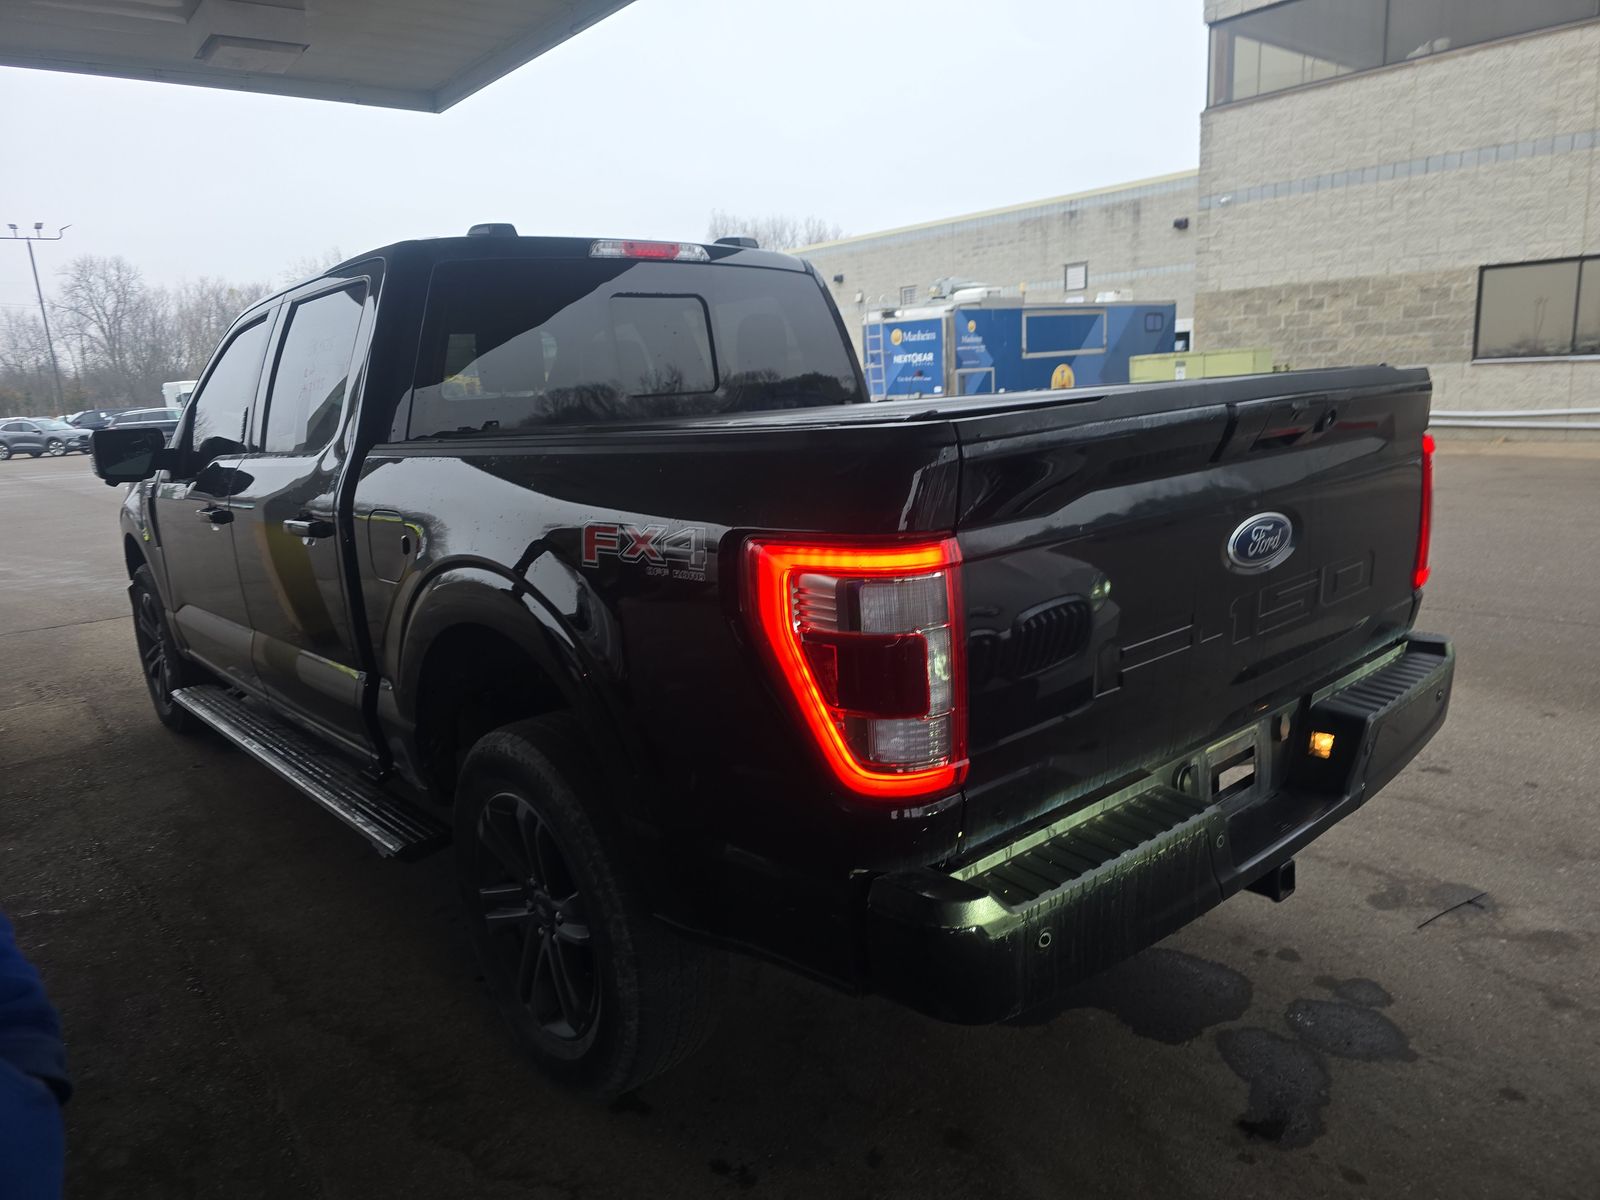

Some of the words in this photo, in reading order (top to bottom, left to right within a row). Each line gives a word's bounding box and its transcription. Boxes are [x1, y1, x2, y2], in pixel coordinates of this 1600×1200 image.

[582, 520, 708, 571] FX4
[1248, 523, 1283, 558] Ford
[1093, 549, 1376, 699] F-150
